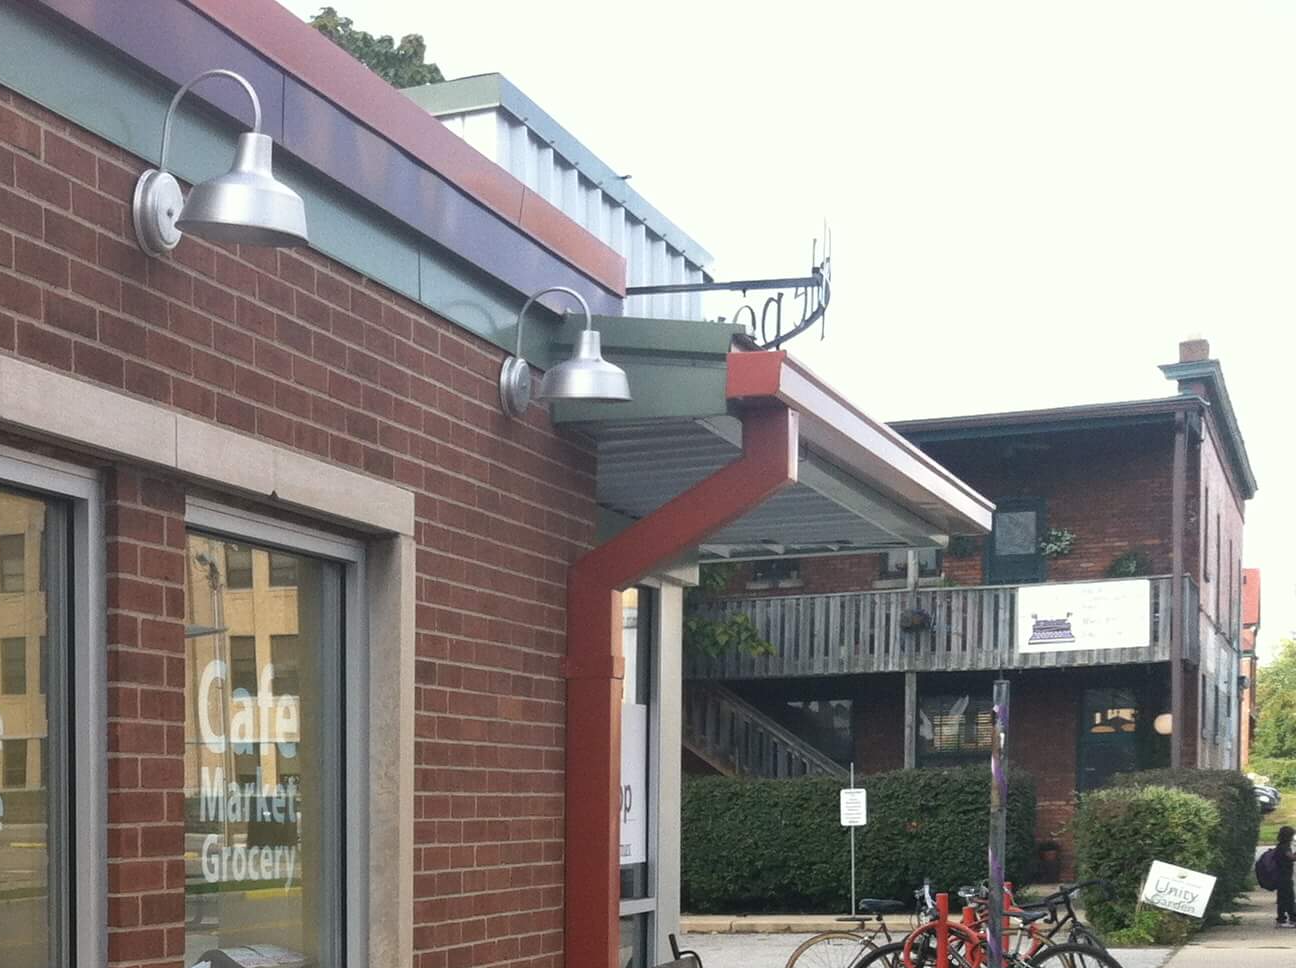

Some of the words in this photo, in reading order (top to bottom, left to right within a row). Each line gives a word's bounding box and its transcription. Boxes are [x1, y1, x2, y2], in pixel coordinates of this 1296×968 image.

[198, 660, 301, 758] Cafe
[199, 766, 300, 824] Market
[201, 833, 298, 893] Grocery
[1155, 879, 1200, 904] Unity
